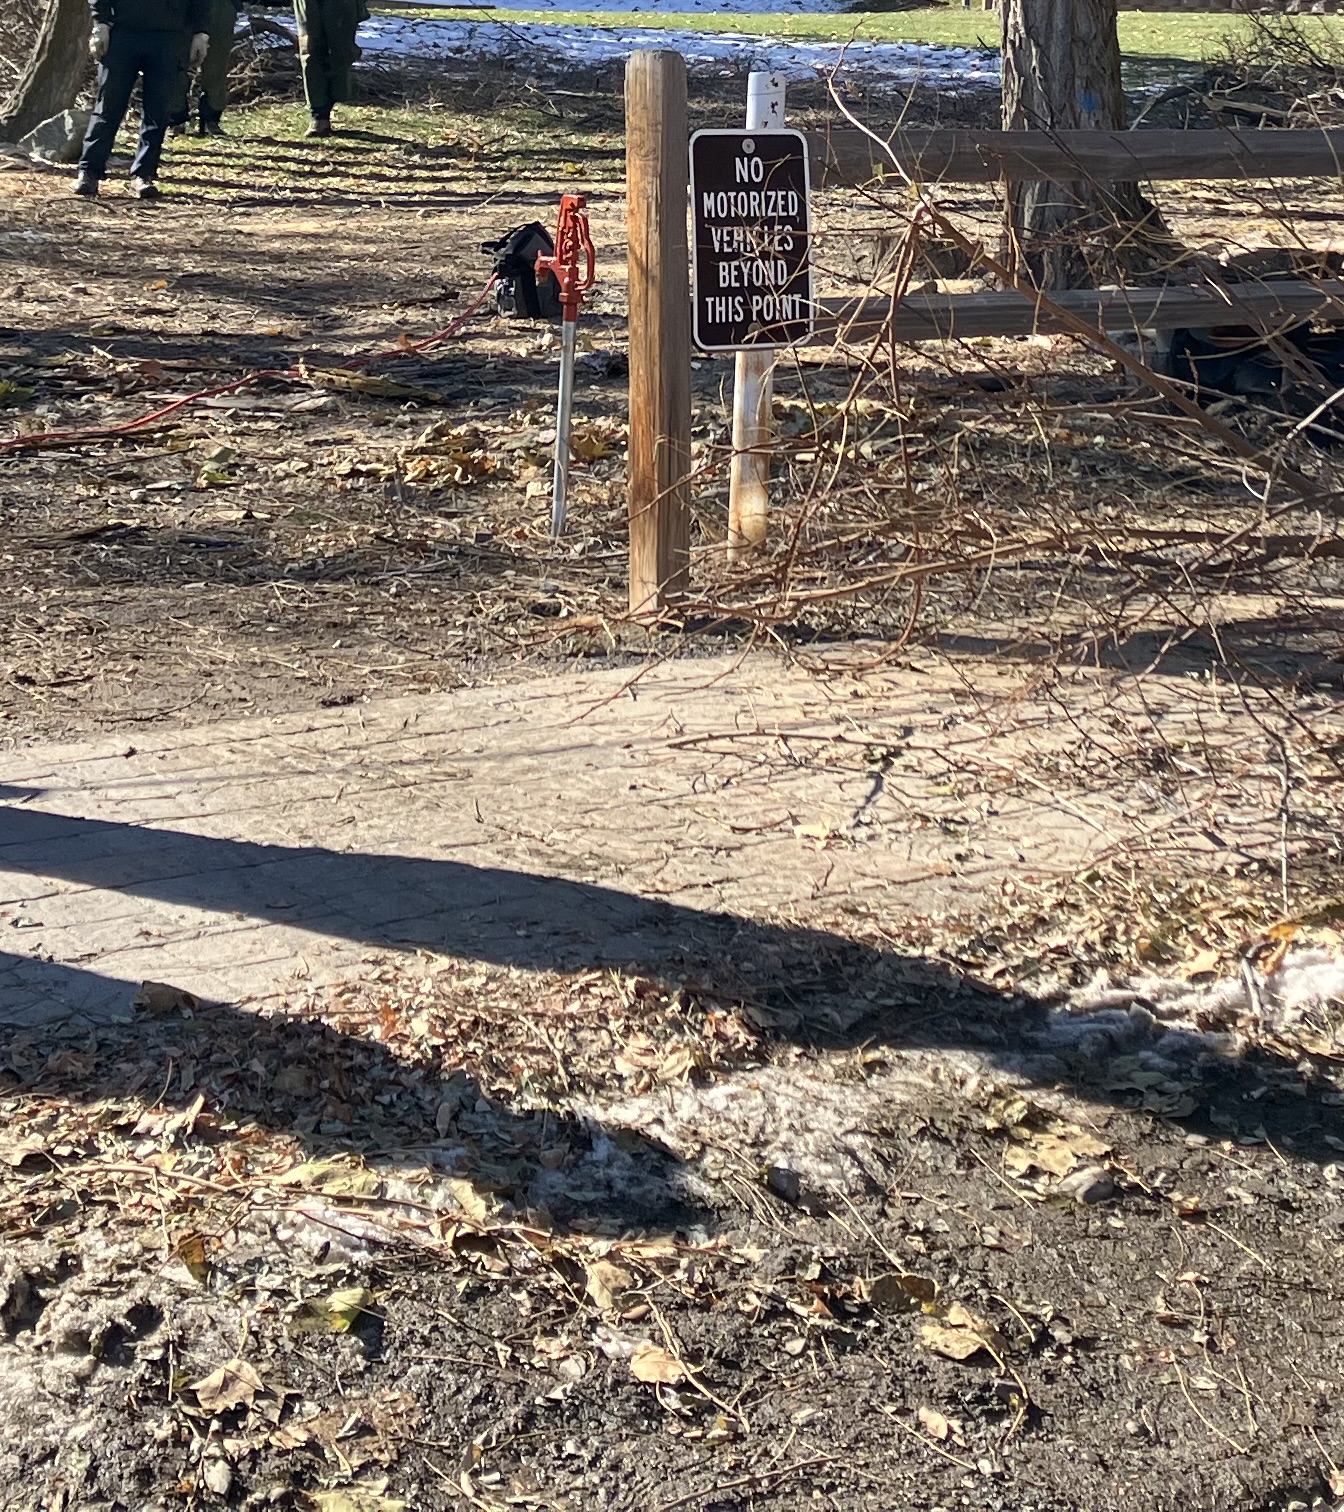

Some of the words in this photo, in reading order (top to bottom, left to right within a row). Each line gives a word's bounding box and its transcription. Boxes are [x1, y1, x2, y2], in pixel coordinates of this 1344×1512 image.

[735, 156, 764, 183] NO
[703, 191, 798, 218] MOTORIZED
[711, 225, 794, 253] VEHICLES
[719, 260, 787, 288] BEYOND
[706, 296, 744, 323] THIS
[752, 294, 802, 322] POINT
